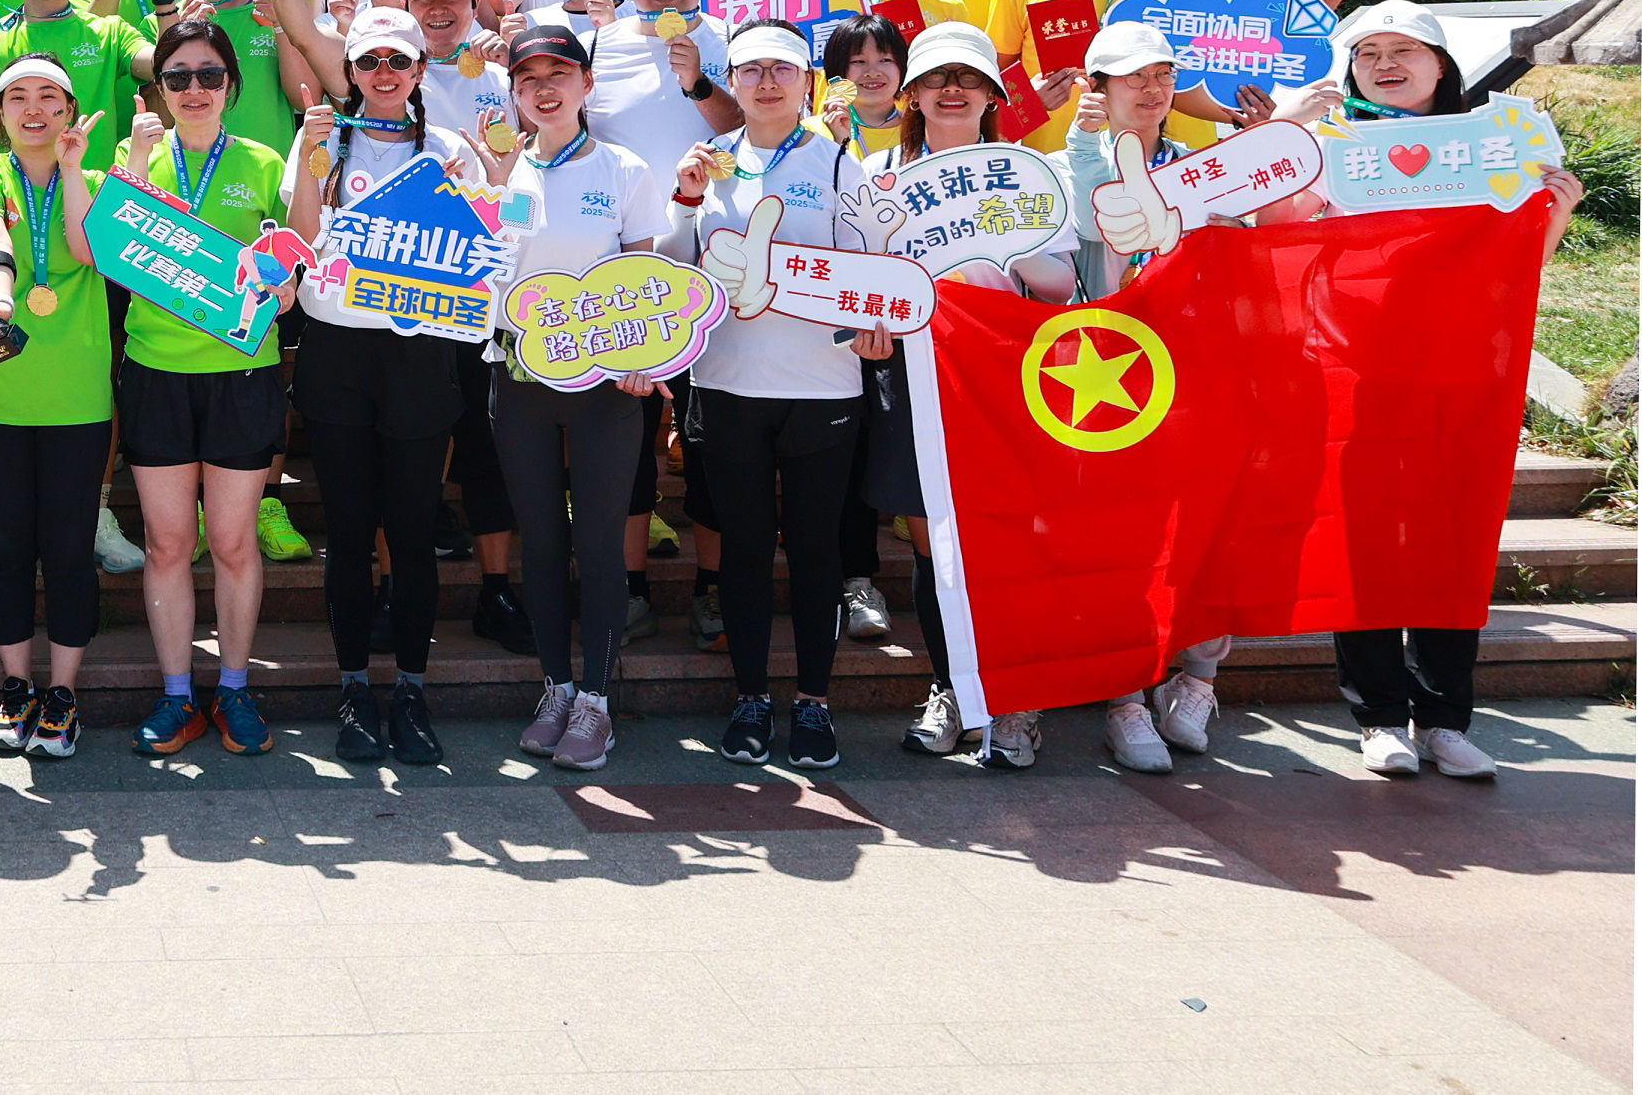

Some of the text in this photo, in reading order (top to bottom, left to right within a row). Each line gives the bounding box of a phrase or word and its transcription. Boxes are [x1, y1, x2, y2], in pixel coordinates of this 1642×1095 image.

[1042, 17, 1088, 34] 荣誉证书
[1142, 6, 1273, 44] 全面协同
[73, 59, 92, 68] 2025
[1174, 45, 1307, 81] 奋进中圣
[1180, 157, 1228, 189] 中圣
[1344, 135, 1518, 181] 我 中圣
[221, 198, 243, 208] 2025
[785, 198, 808, 208] 2025
[902, 159, 1020, 216] 我就是
[112, 198, 223, 263] 友谊第一
[581, 208, 603, 216] 2025
[315, 205, 520, 284] 深耕业务
[119, 239, 234, 311] 比赛第二
[786, 254, 832, 281] 中圣
[353, 277, 489, 329] 全球中圣
[535, 276, 672, 328] 志在心中
[542, 311, 680, 363] 路在脚下
